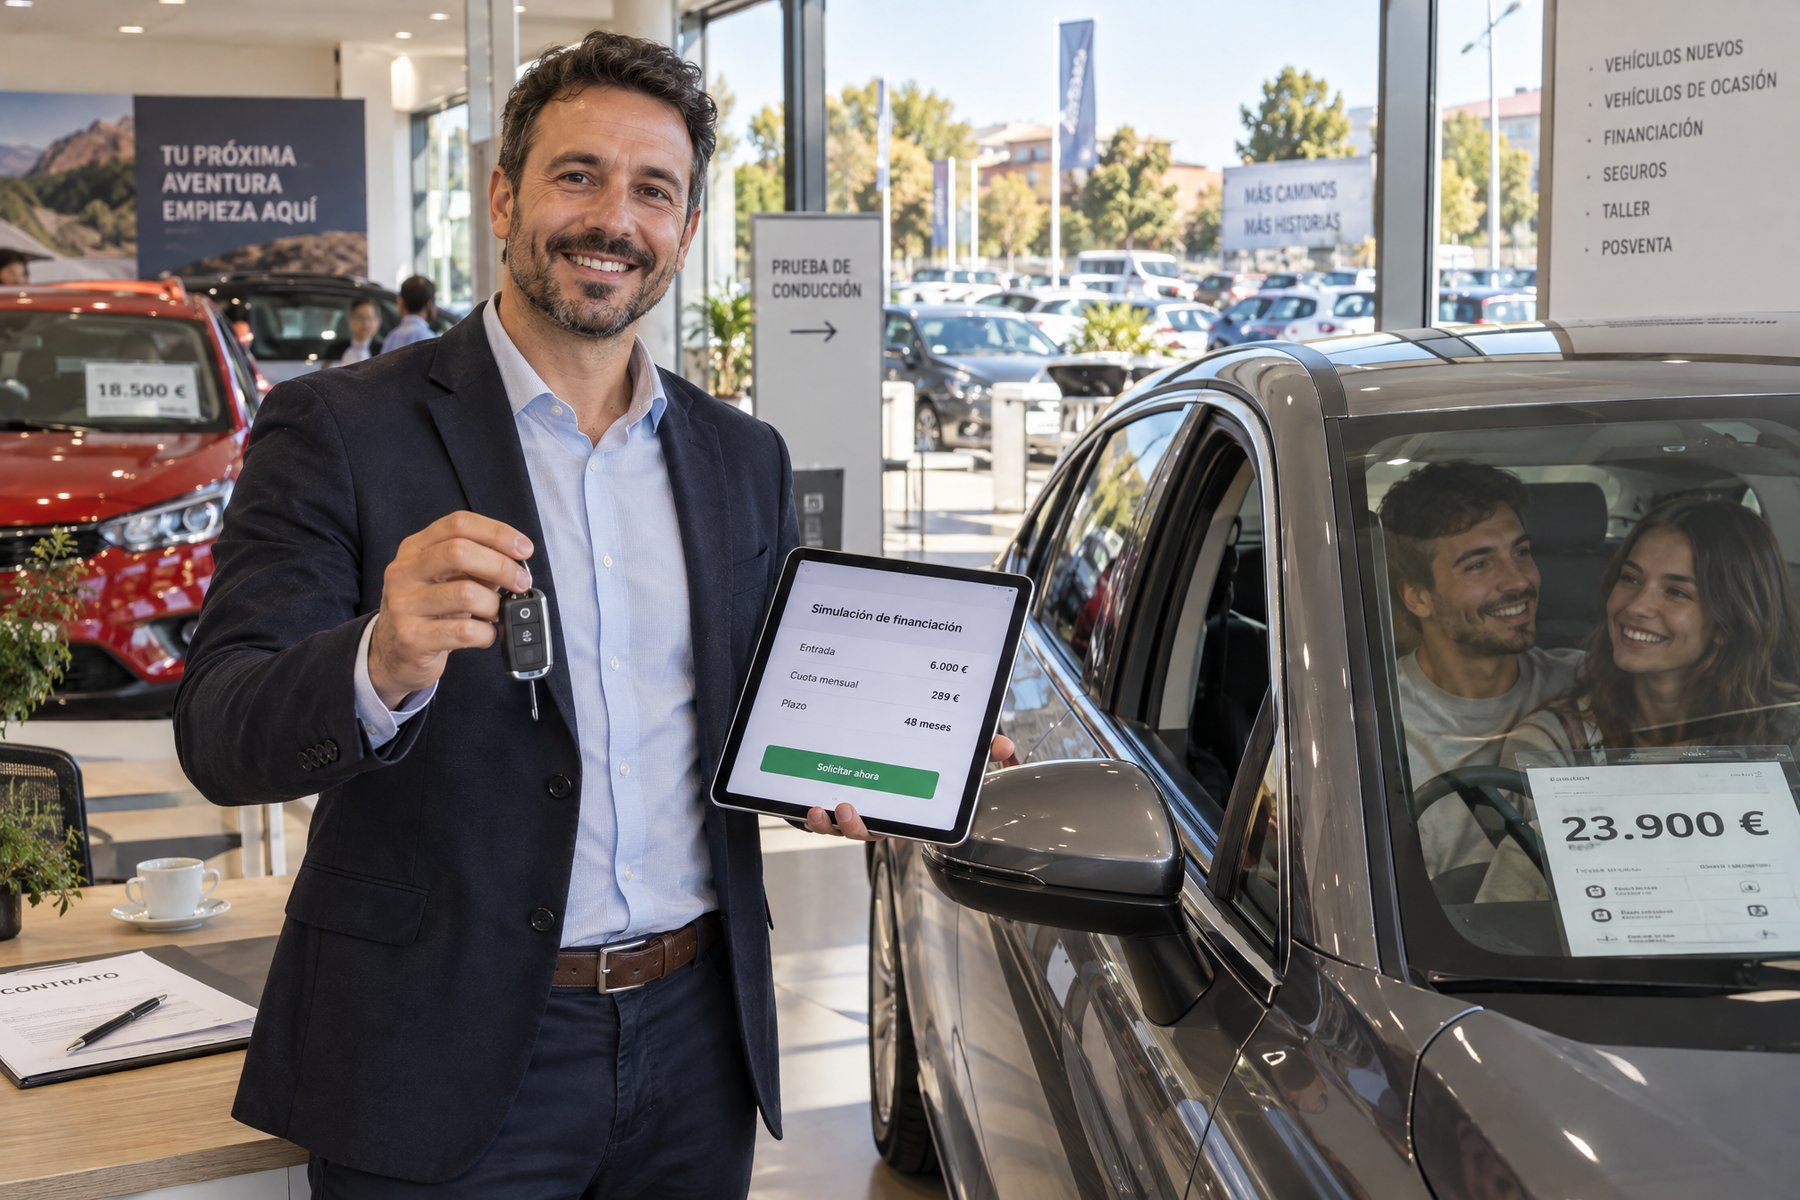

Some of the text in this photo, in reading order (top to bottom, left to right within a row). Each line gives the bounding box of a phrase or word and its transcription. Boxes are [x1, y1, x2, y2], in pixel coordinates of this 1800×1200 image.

[1605, 39, 1744, 73] VEHÍCULOS NUEVOS
[1604, 68, 1777, 109] VEHÍCULOS DE OCASIÓN
[1604, 116, 1704, 145] FINANCIACIÓN
[160, 139, 297, 167] TU PRÓXIMA
[1603, 161, 1668, 182] SEGUROS
[161, 172, 283, 194] AVENTURA
[1244, 180, 1337, 203] MÁS CAMINOS
[162, 195, 318, 224] EMPIEZA AQUÍ
[1602, 201, 1650, 219] TALLER
[1244, 212, 1341, 235] MÁS HISTORIAS
[1602, 236, 1673, 256] POSVENTA
[772, 259, 851, 275] PRUEBA DE
[772, 279, 862, 299] CONDUCCIÓN
[98, 382, 187, 399] 18.500 €
[811, 603, 963, 633] Simulación de financiación
[799, 643, 836, 656] Entrada
[930, 660, 969, 674] 6.000 €
[790, 671, 859, 689] Cuota mensual
[781, 698, 807, 711] Plazo
[931, 690, 960, 703] 289 €
[904, 717, 952, 732] 48 meses
[817, 762, 880, 781] Solicitar ahora
[1561, 810, 1769, 842] 23.900 €
[1, 972, 119, 995] CONTRATO
